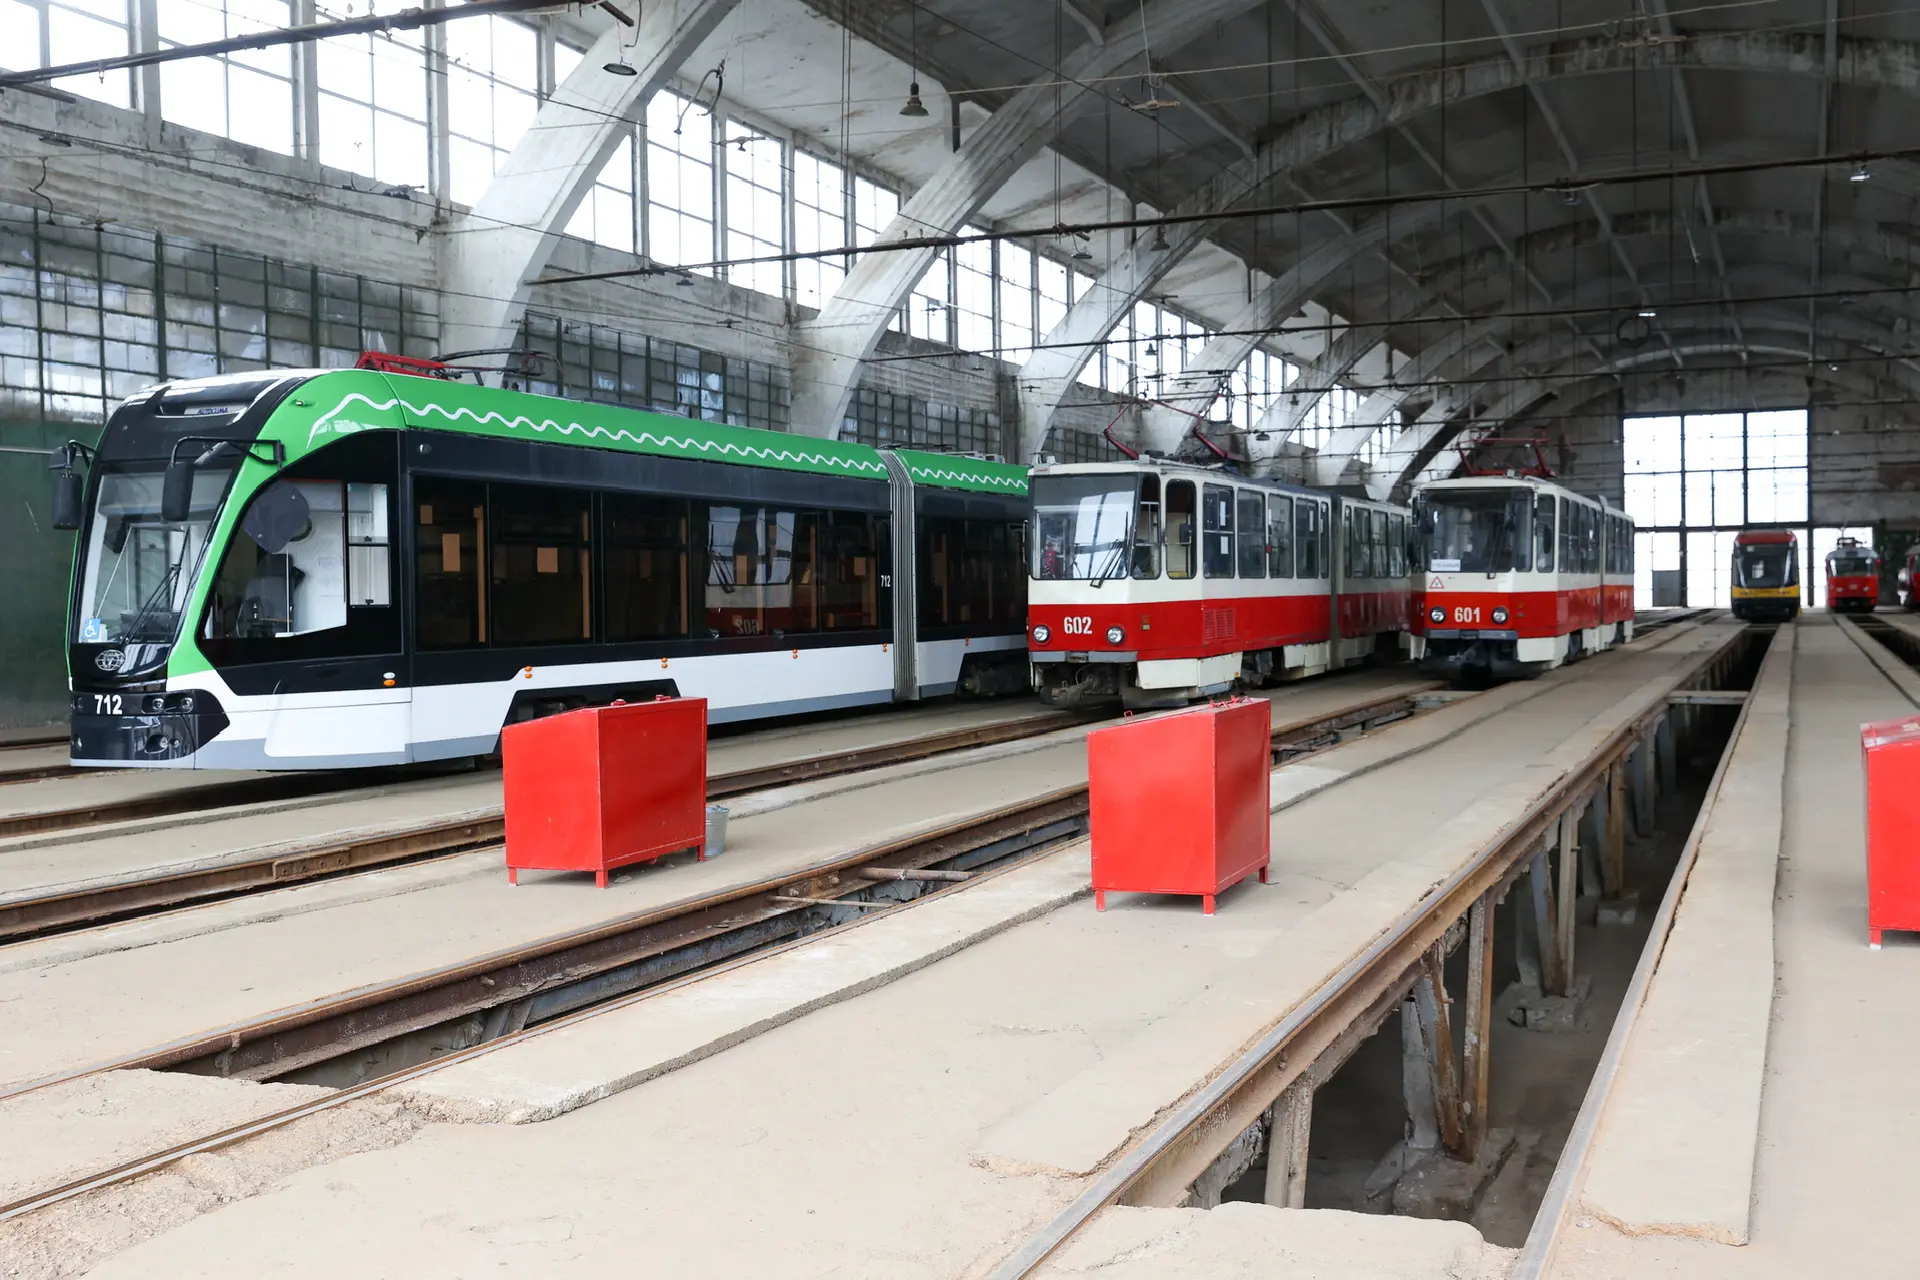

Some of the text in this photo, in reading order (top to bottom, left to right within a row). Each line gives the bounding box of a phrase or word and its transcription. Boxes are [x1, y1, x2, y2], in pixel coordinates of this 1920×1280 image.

[881, 575, 890, 587] 712
[1454, 606, 1480, 623] 601
[1064, 616, 1093, 634] 602
[94, 694, 122, 715] 712
